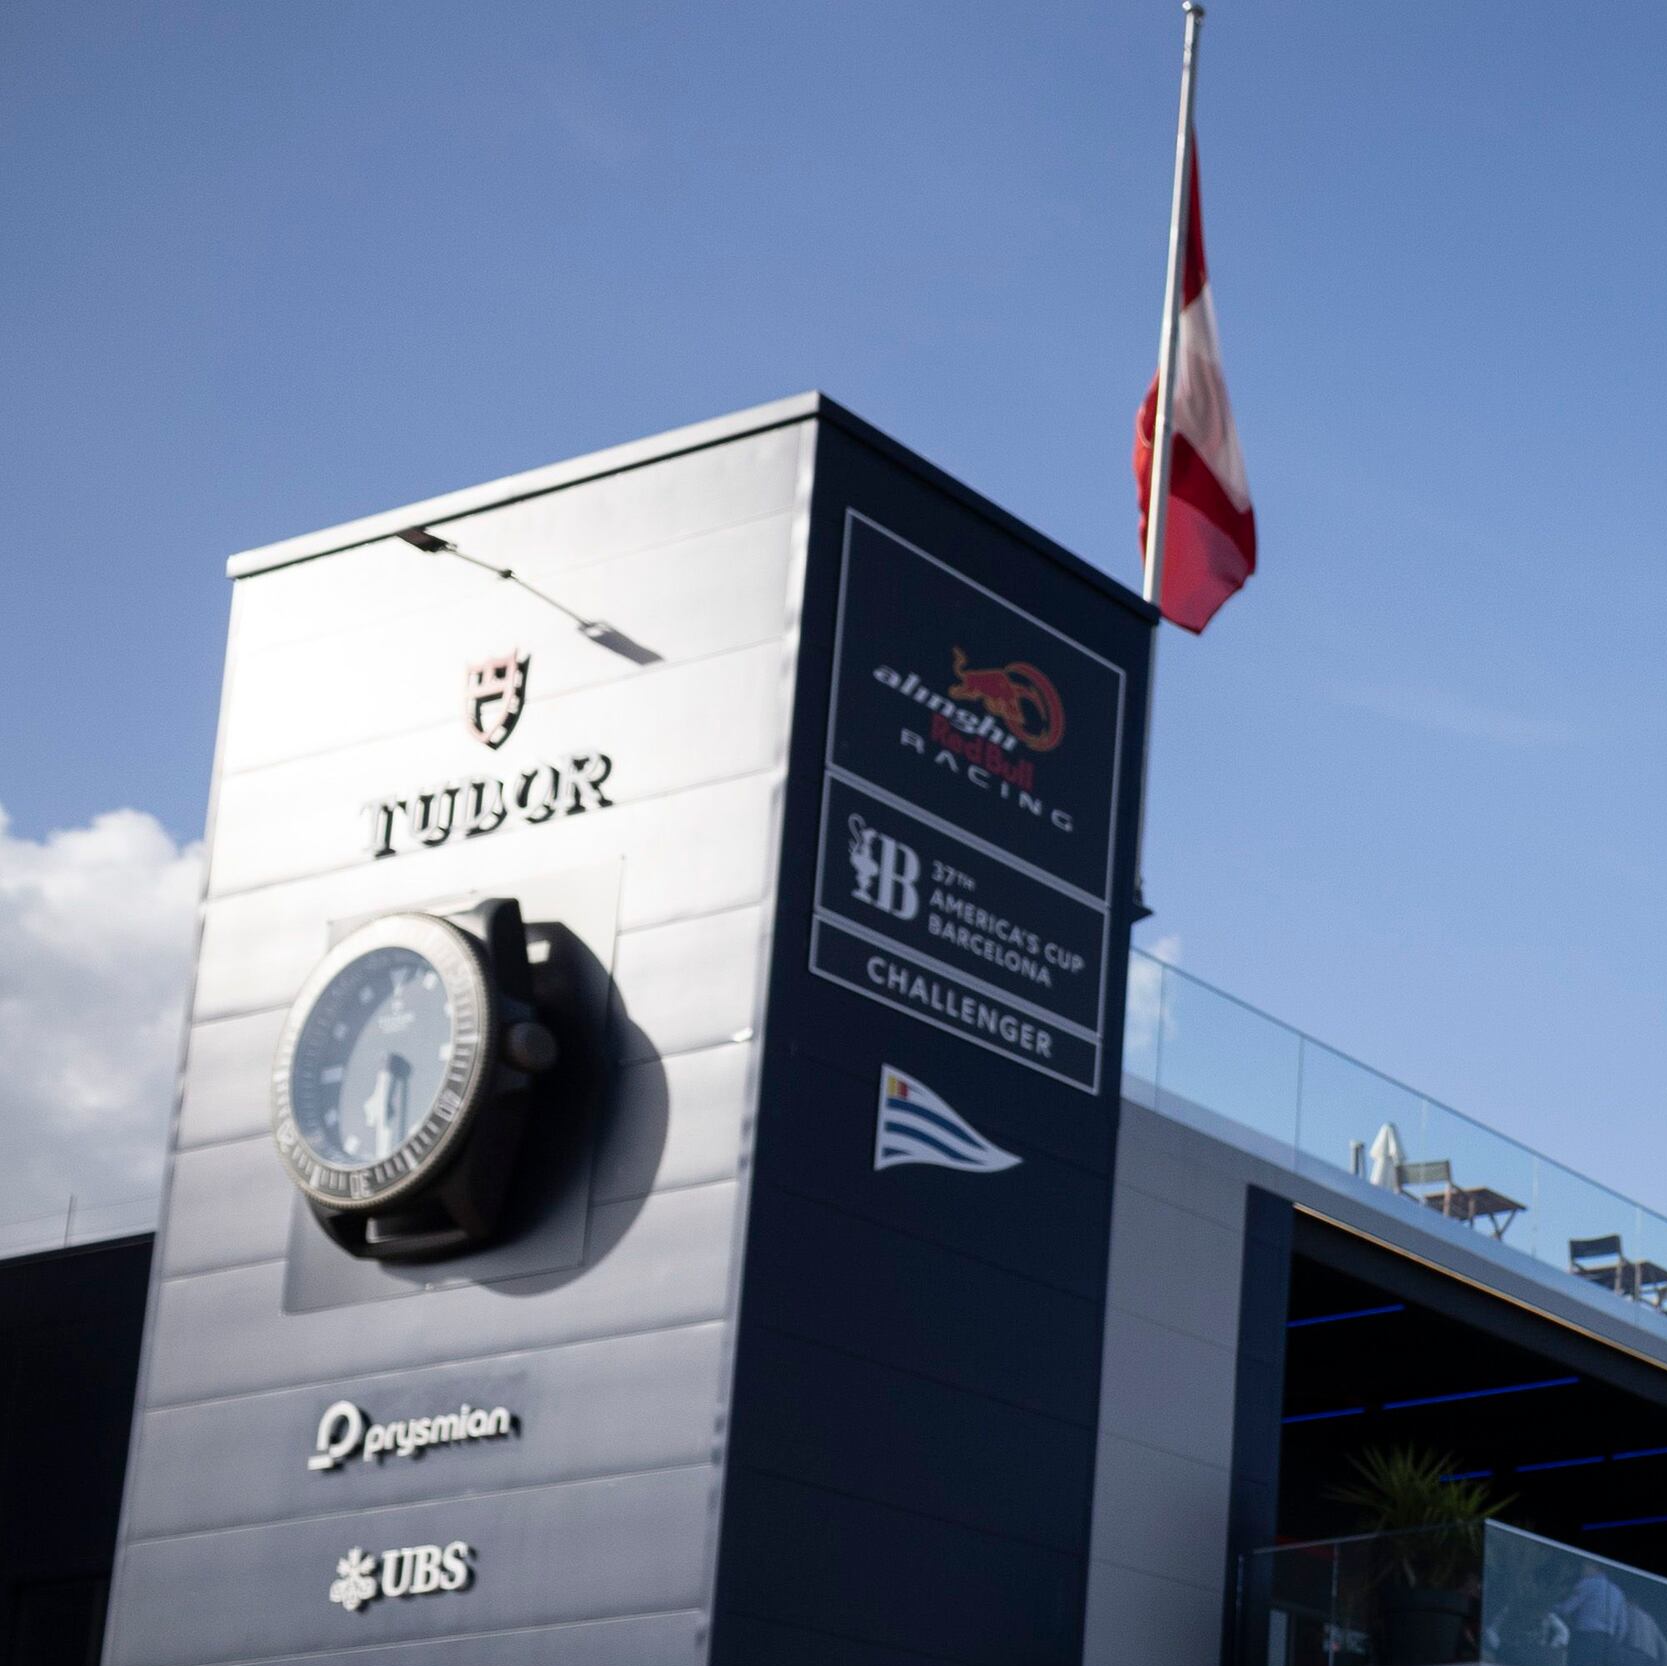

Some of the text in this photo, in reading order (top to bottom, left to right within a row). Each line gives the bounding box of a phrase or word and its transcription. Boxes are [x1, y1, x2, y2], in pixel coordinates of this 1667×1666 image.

[872, 664, 1019, 751] alinghi
[360, 750, 614, 860] TUDOR
[900, 728, 1073, 832] RACING
[984, 740, 1035, 792] Bull
[927, 913, 1051, 988] BARCELONA
[930, 889, 1086, 973] AMERICA'S CUP
[865, 955, 1051, 1058] CHALLENGER
[363, 1403, 510, 1462] prysmian
[381, 1540, 468, 1597] UBS
